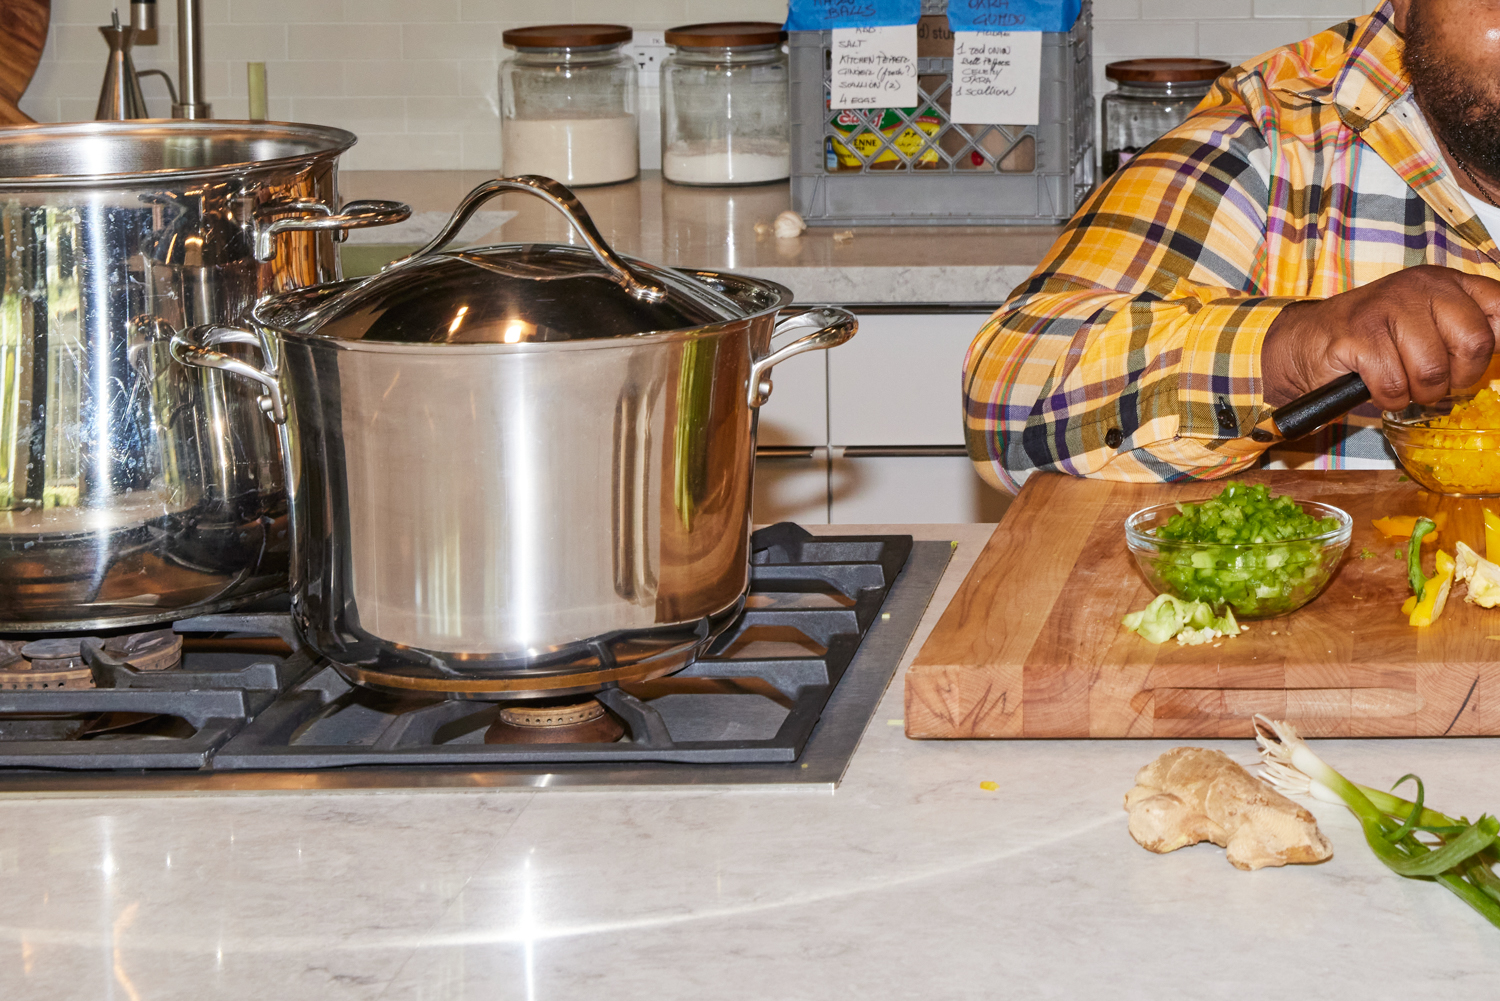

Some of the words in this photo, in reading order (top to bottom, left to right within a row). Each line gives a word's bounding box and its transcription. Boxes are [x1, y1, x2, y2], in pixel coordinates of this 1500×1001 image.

[824, 4, 877, 20] BALLS
[972, 13, 1026, 27] GUMBO
[838, 39, 867, 48] SALT
[839, 55, 875, 65] KITCHEN
[961, 76, 991, 85] OKRA
[839, 94, 848, 104] 4
